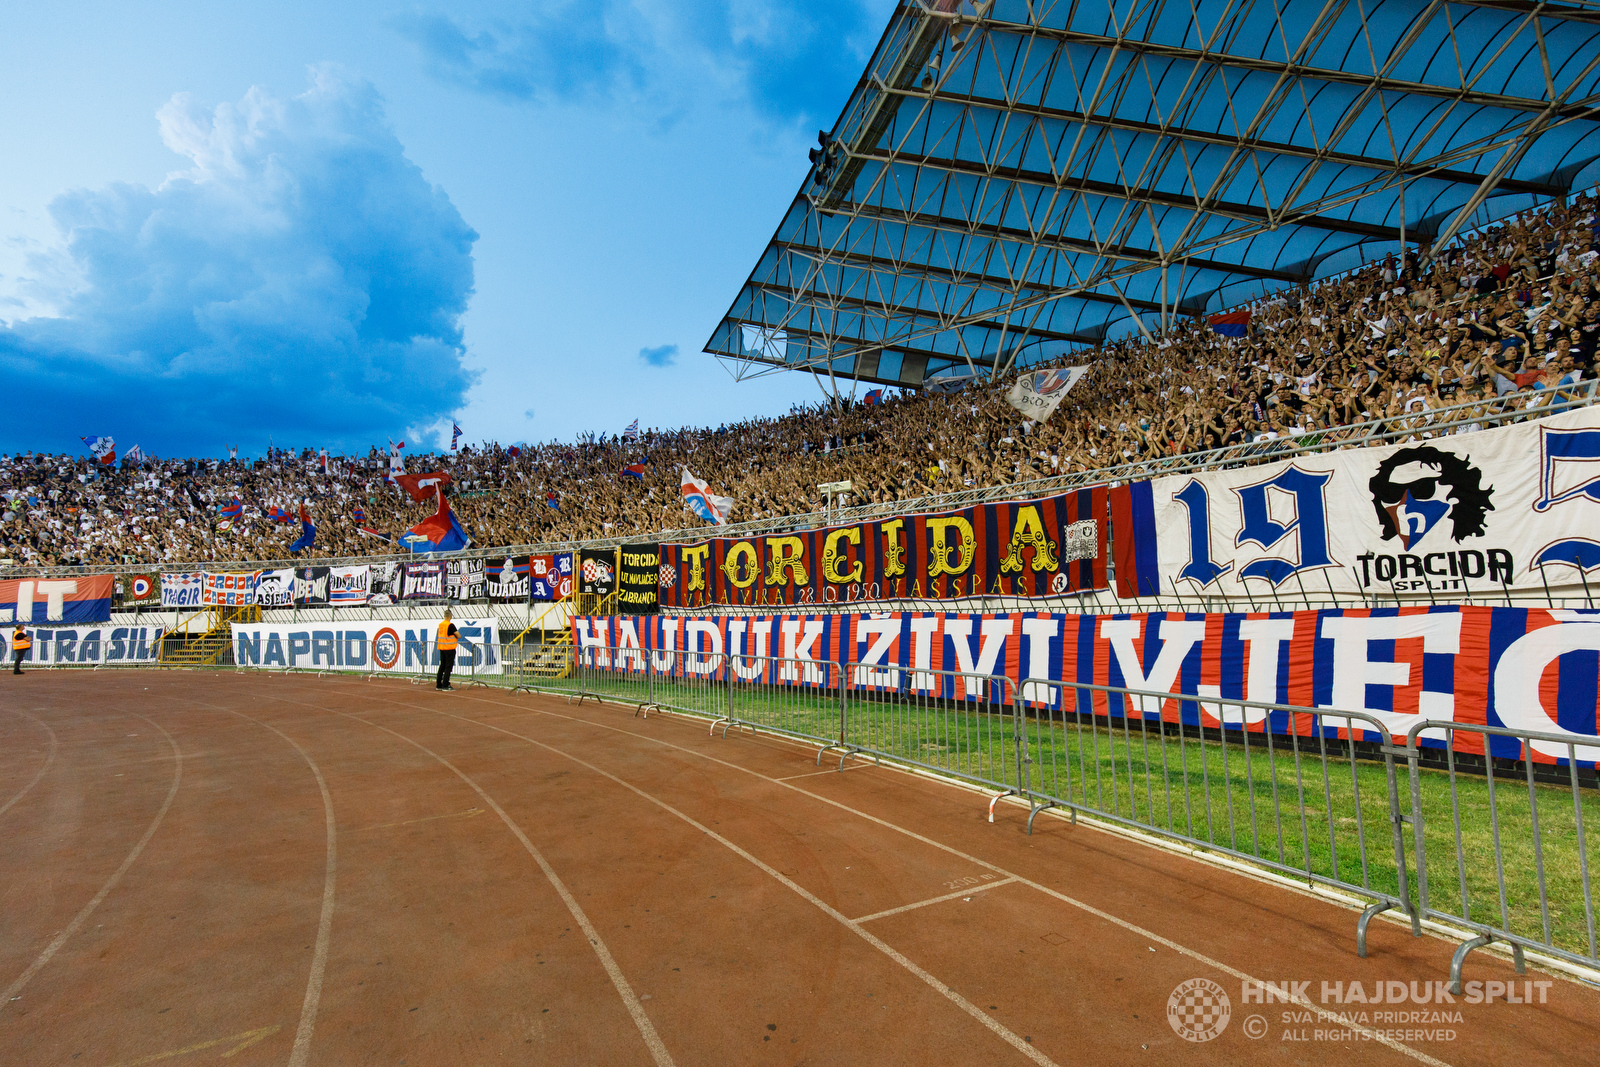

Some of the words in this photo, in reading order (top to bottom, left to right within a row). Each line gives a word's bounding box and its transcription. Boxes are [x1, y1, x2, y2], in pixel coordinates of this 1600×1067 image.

[1172, 462, 1345, 591] 19
[622, 552, 659, 567] TORCIDA
[682, 505, 1061, 592] TORCIDA
[1356, 548, 1514, 588] TORCIDA
[204, 589, 252, 605] ZAGREB
[486, 577, 529, 597] UJANKE
[822, 585, 837, 602] 10.
[846, 582, 880, 601] 1950.
[1394, 578, 1463, 591] SPLIT
[0, 580, 78, 622] IT
[238, 630, 367, 666] NAPRID
[576, 619, 824, 684] HAJDUK
[853, 612, 1059, 706] ŽIVI
[943, 876, 979, 890] 200
